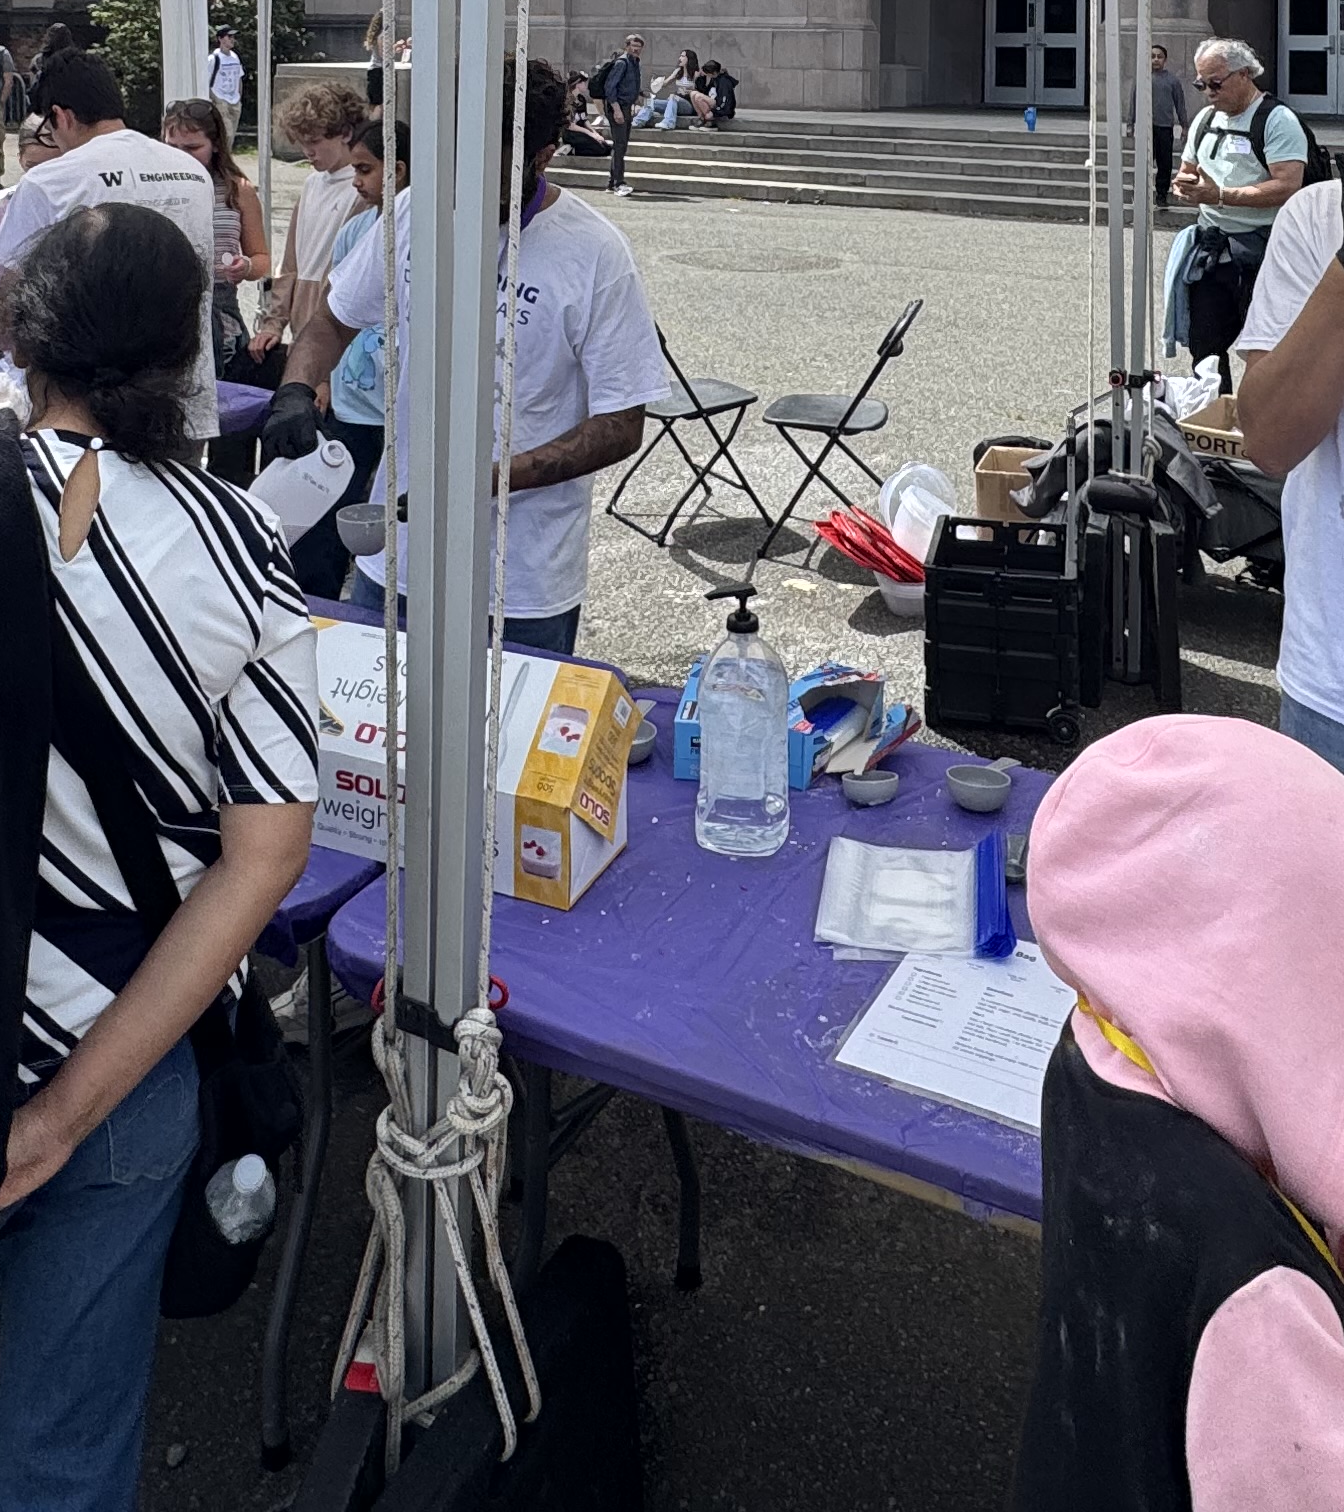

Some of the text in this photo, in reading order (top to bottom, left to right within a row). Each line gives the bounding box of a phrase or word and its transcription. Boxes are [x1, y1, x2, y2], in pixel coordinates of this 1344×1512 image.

[98, 170, 206, 188] W ENGINEERING
[588, 757, 617, 796] Spoons
[579, 792, 611, 826] SOLO
[1015, 950, 1037, 963] Bag
